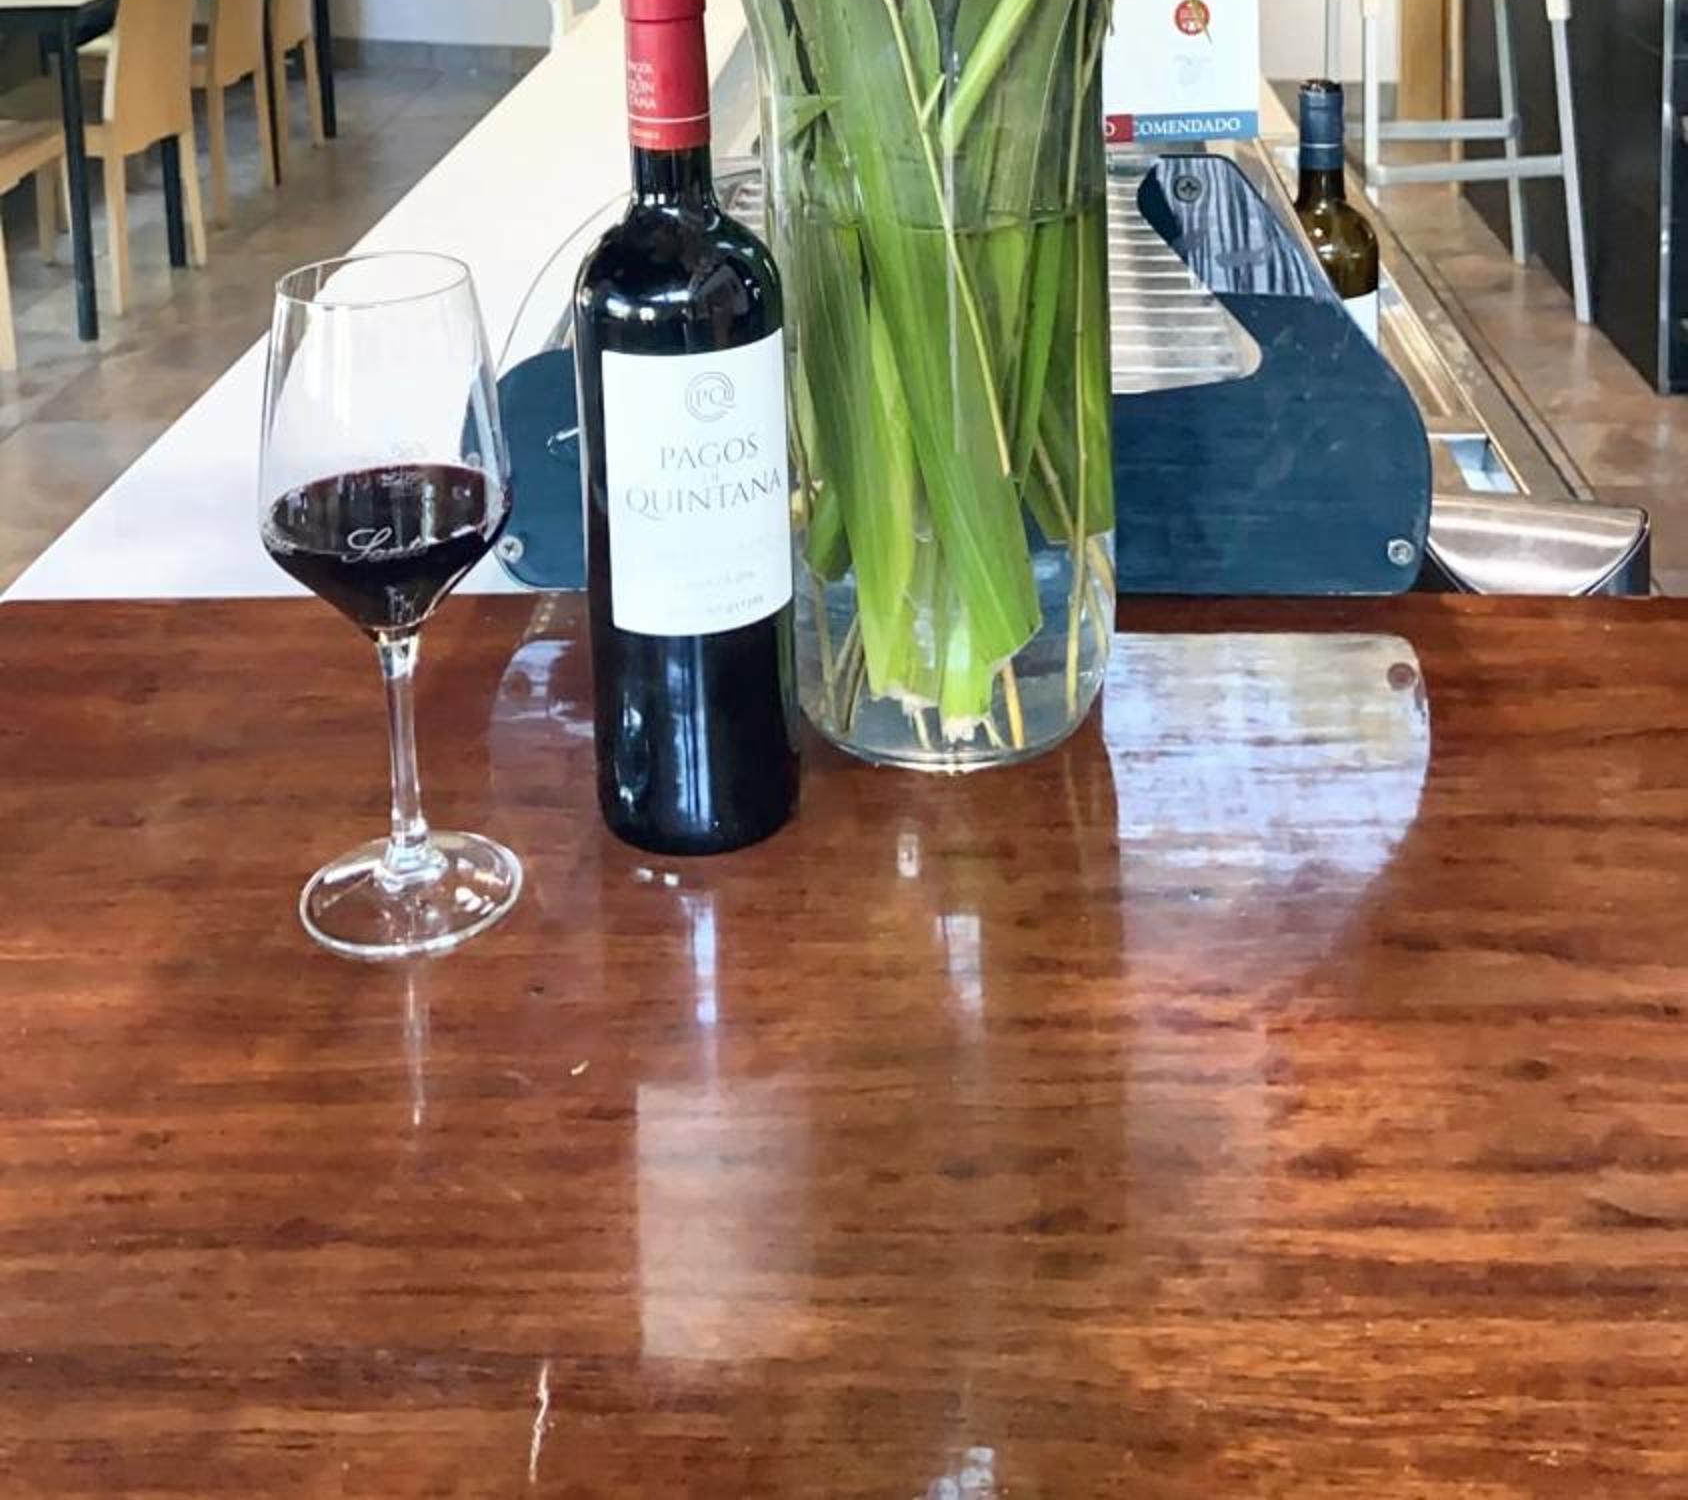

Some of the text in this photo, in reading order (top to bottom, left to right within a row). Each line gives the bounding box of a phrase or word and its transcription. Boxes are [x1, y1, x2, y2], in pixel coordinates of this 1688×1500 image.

[1132, 117, 1241, 136] COMENDADO
[661, 432, 758, 469] PAGOS
[626, 467, 782, 521] QUINTANA
